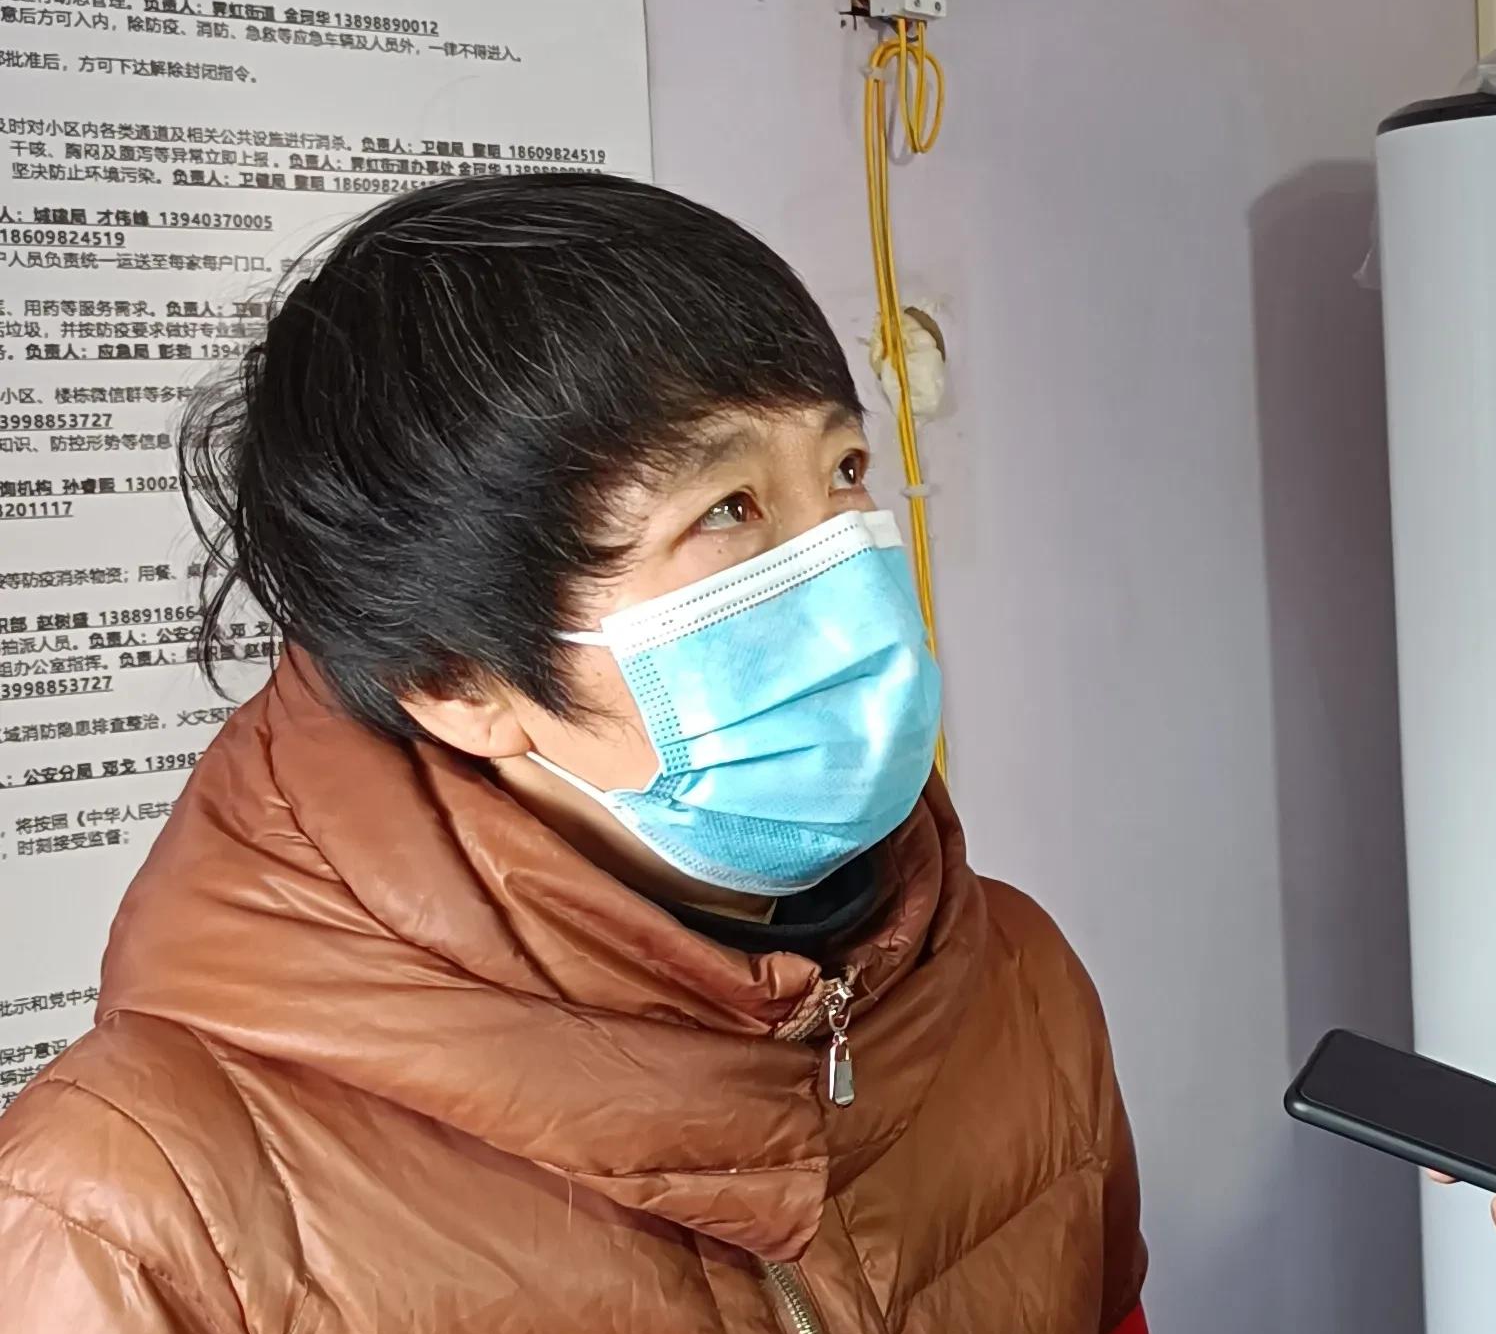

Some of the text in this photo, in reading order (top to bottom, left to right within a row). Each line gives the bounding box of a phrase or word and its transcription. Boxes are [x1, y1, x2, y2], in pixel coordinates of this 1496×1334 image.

[334, 12, 439, 35] 13898890012
[508, 144, 606, 164] 18609824519
[333, 174, 433, 193] 186098245
[159, 211, 272, 229] 13940370005
[1, 229, 125, 246] 18609824519
[0, 501, 72, 517] 201117
[1, 675, 113, 699] 3998853727
[0, 763, 92, 786] ：公安分局
